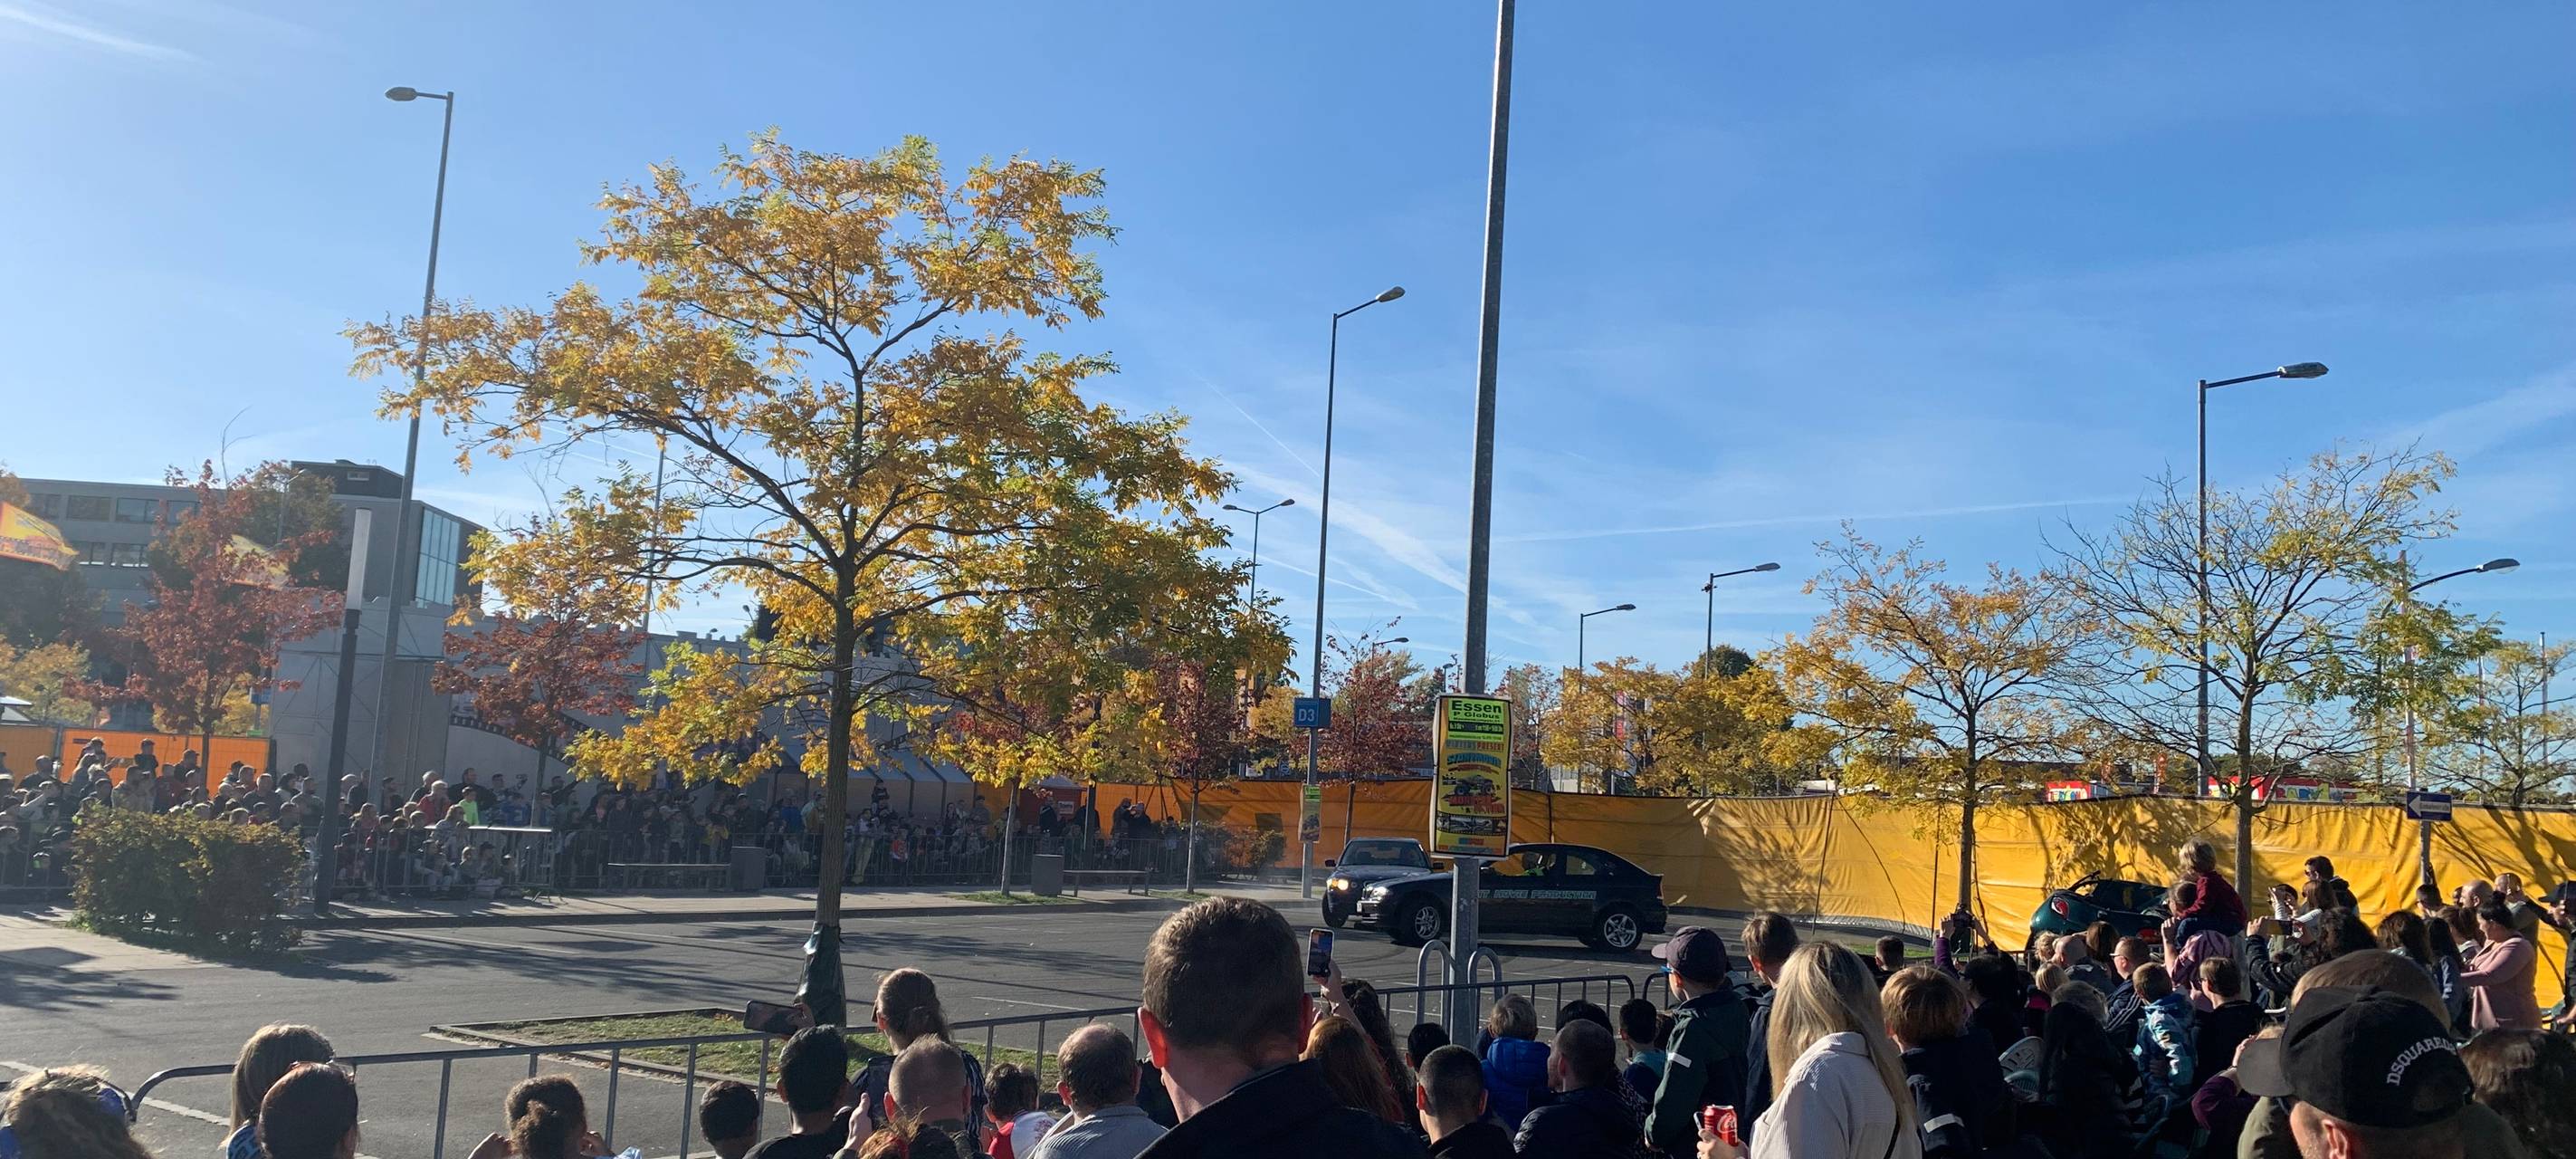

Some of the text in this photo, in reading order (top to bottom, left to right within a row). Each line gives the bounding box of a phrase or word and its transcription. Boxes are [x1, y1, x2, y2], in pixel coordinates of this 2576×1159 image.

[1452, 700, 1502, 714] Essen
[1298, 708, 1315, 723] D3
[1531, 889, 1597, 900] PRODUCTION
